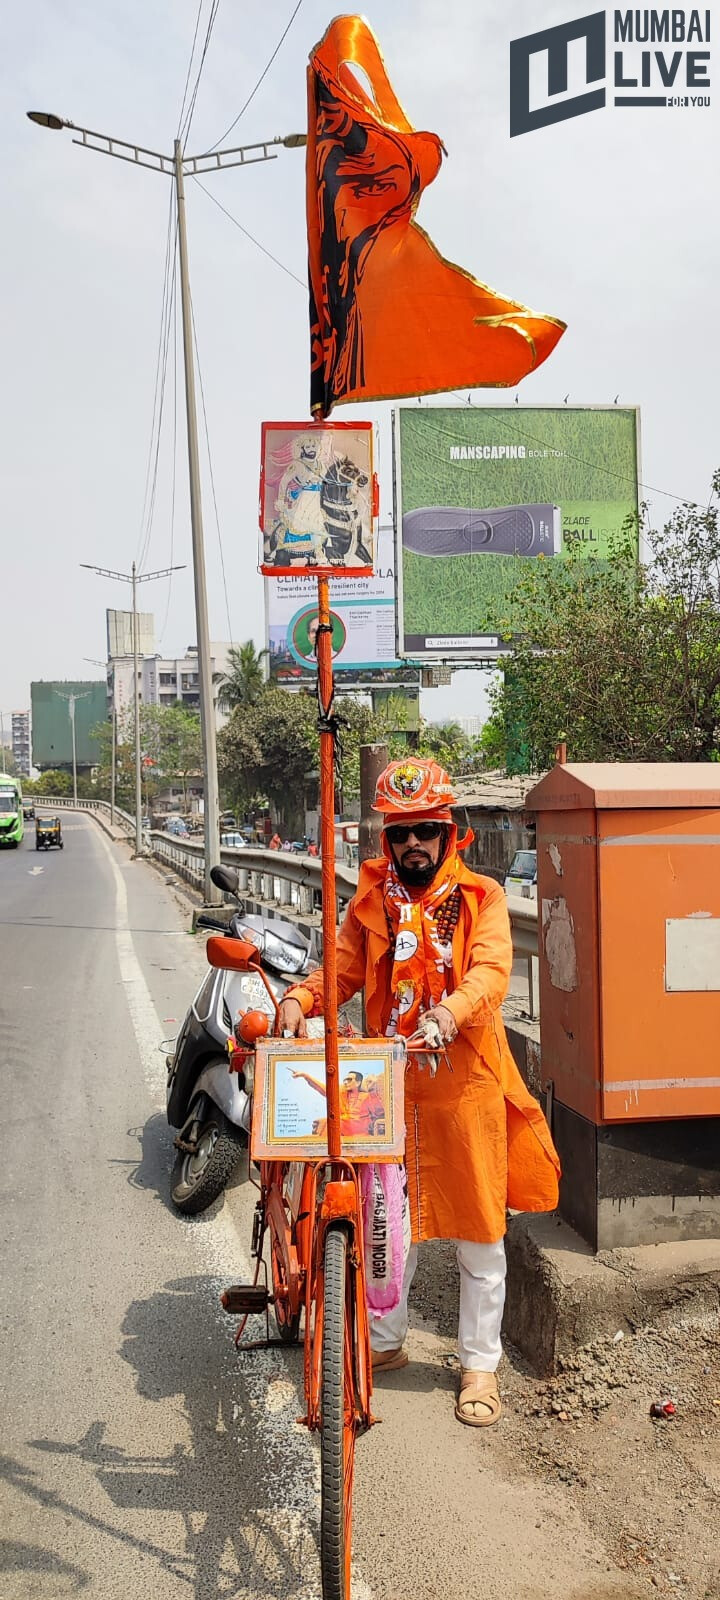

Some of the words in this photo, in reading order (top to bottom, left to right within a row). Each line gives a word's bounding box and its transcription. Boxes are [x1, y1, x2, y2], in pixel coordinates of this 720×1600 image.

[449, 445, 526, 460] MANSCAPING
[563, 516, 590, 525] ZLADE
[372, 1244, 387, 1279] MOGRA
